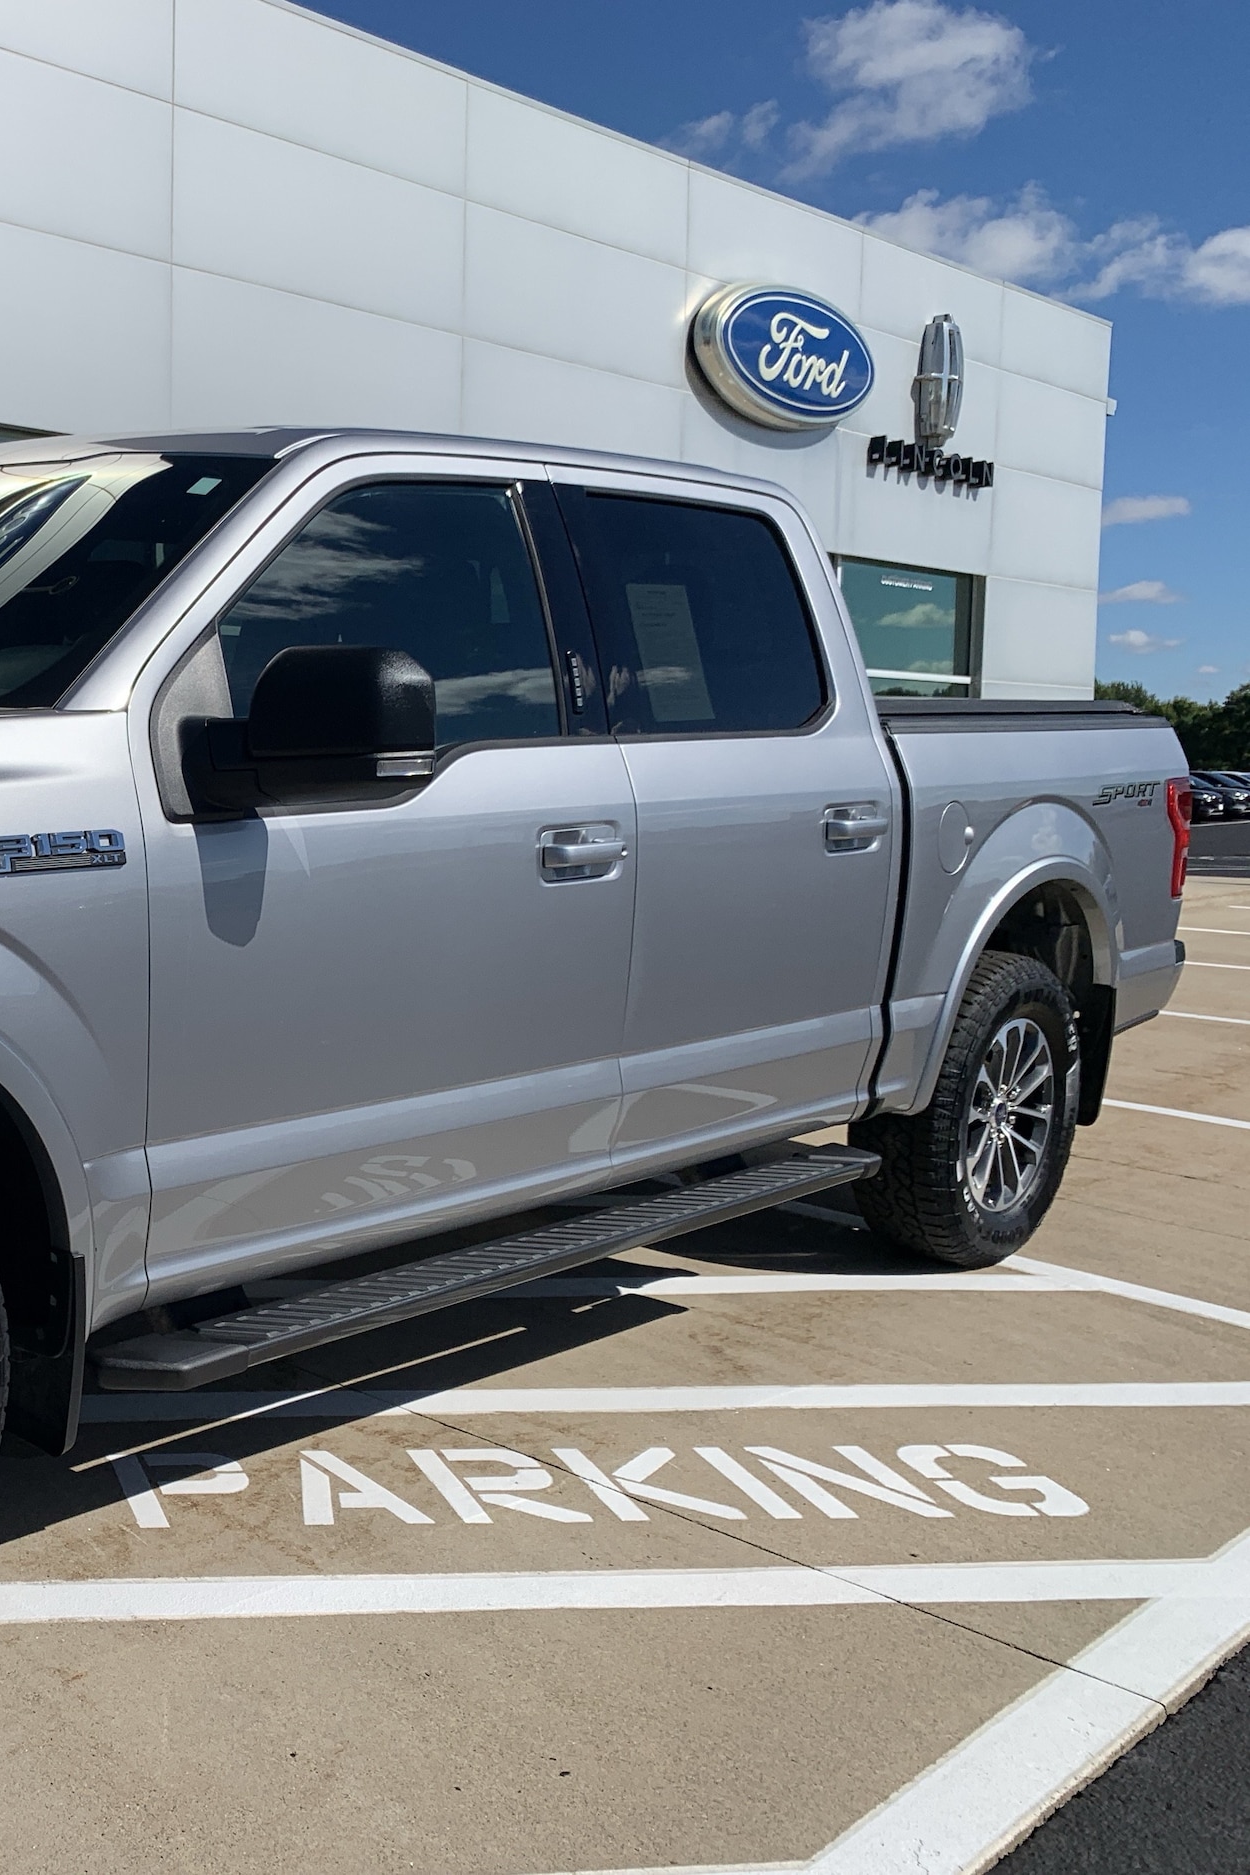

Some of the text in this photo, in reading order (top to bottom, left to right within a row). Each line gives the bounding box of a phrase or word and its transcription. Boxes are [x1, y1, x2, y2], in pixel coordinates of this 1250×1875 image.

[758, 312, 850, 399] Ford
[1092, 781, 1161, 807] SPORT
[92, 853, 121, 865] XLT
[105, 1442, 1091, 1529] PARKING
